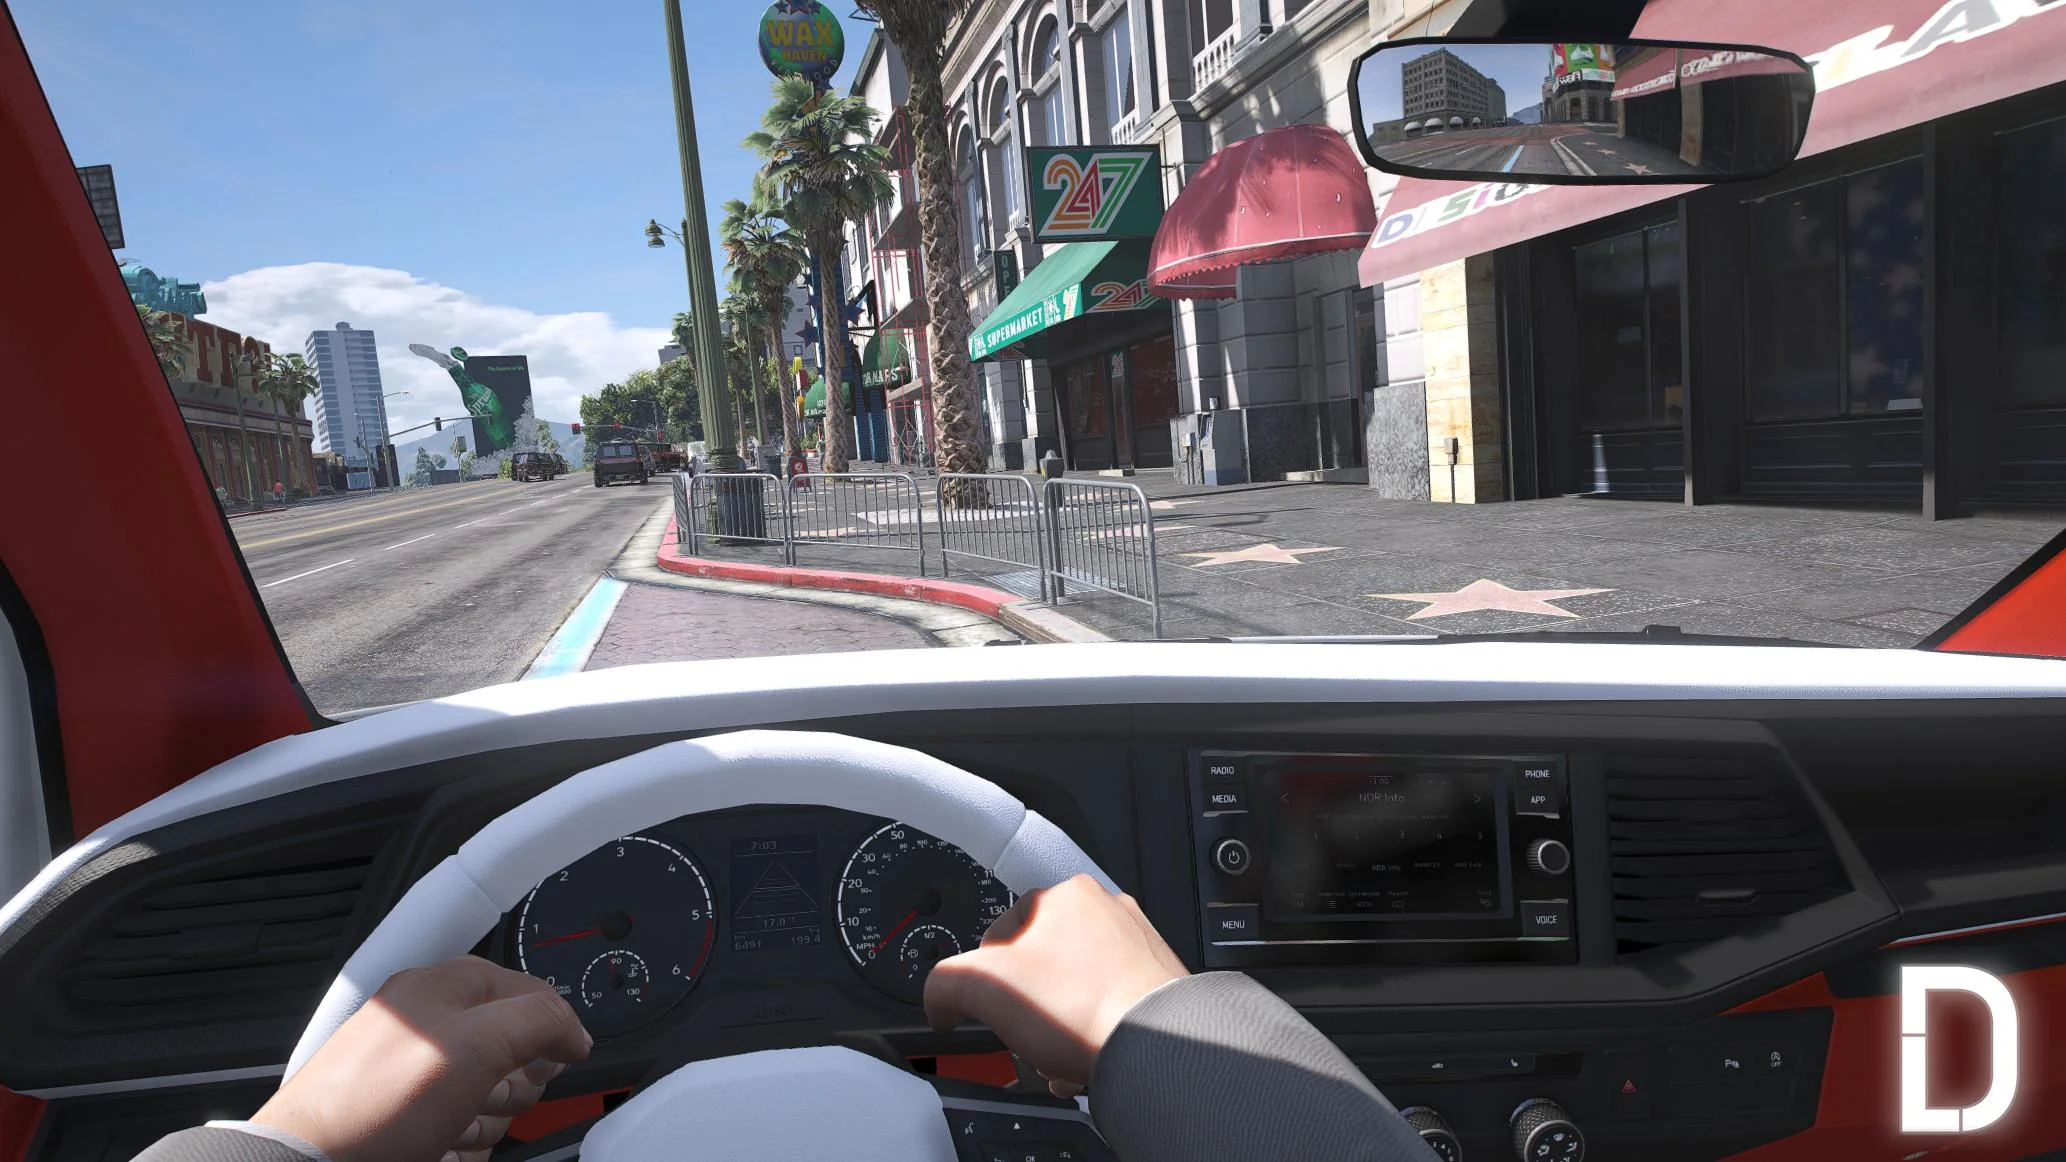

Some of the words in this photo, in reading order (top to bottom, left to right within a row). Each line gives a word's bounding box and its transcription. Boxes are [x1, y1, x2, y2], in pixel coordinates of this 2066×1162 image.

[767, 19, 834, 48] WAX
[782, 50, 828, 62] HAVEN
[1040, 152, 1152, 236] 247
[1001, 254, 1011, 297] OPE
[987, 307, 1044, 348] SUPERMARKET
[1210, 766, 1235, 775] RADIO
[1525, 769, 1551, 779] PHONE
[1211, 794, 1237, 804] MEDIA
[1531, 795, 1546, 804] APP
[890, 830, 905, 840] 50
[616, 846, 625, 857] 3
[862, 853, 876, 863] 30
[668, 863, 676, 873] 4
[559, 871, 569, 882] 2
[847, 879, 863, 889] 20
[692, 909, 700, 920] 5
[988, 906, 1007, 915] 130
[847, 917, 860, 926] 10
[1535, 914, 1558, 924] VOICE
[532, 923, 539, 934] 1
[1222, 919, 1246, 930] MENU
[862, 933, 881, 941] km/h
[856, 942, 876, 950] MPH
[868, 950, 876, 960] 0
[672, 964, 680, 975] 6
[546, 975, 555, 987] 0
[591, 991, 603, 999] 50
[627, 988, 640, 996] 130
